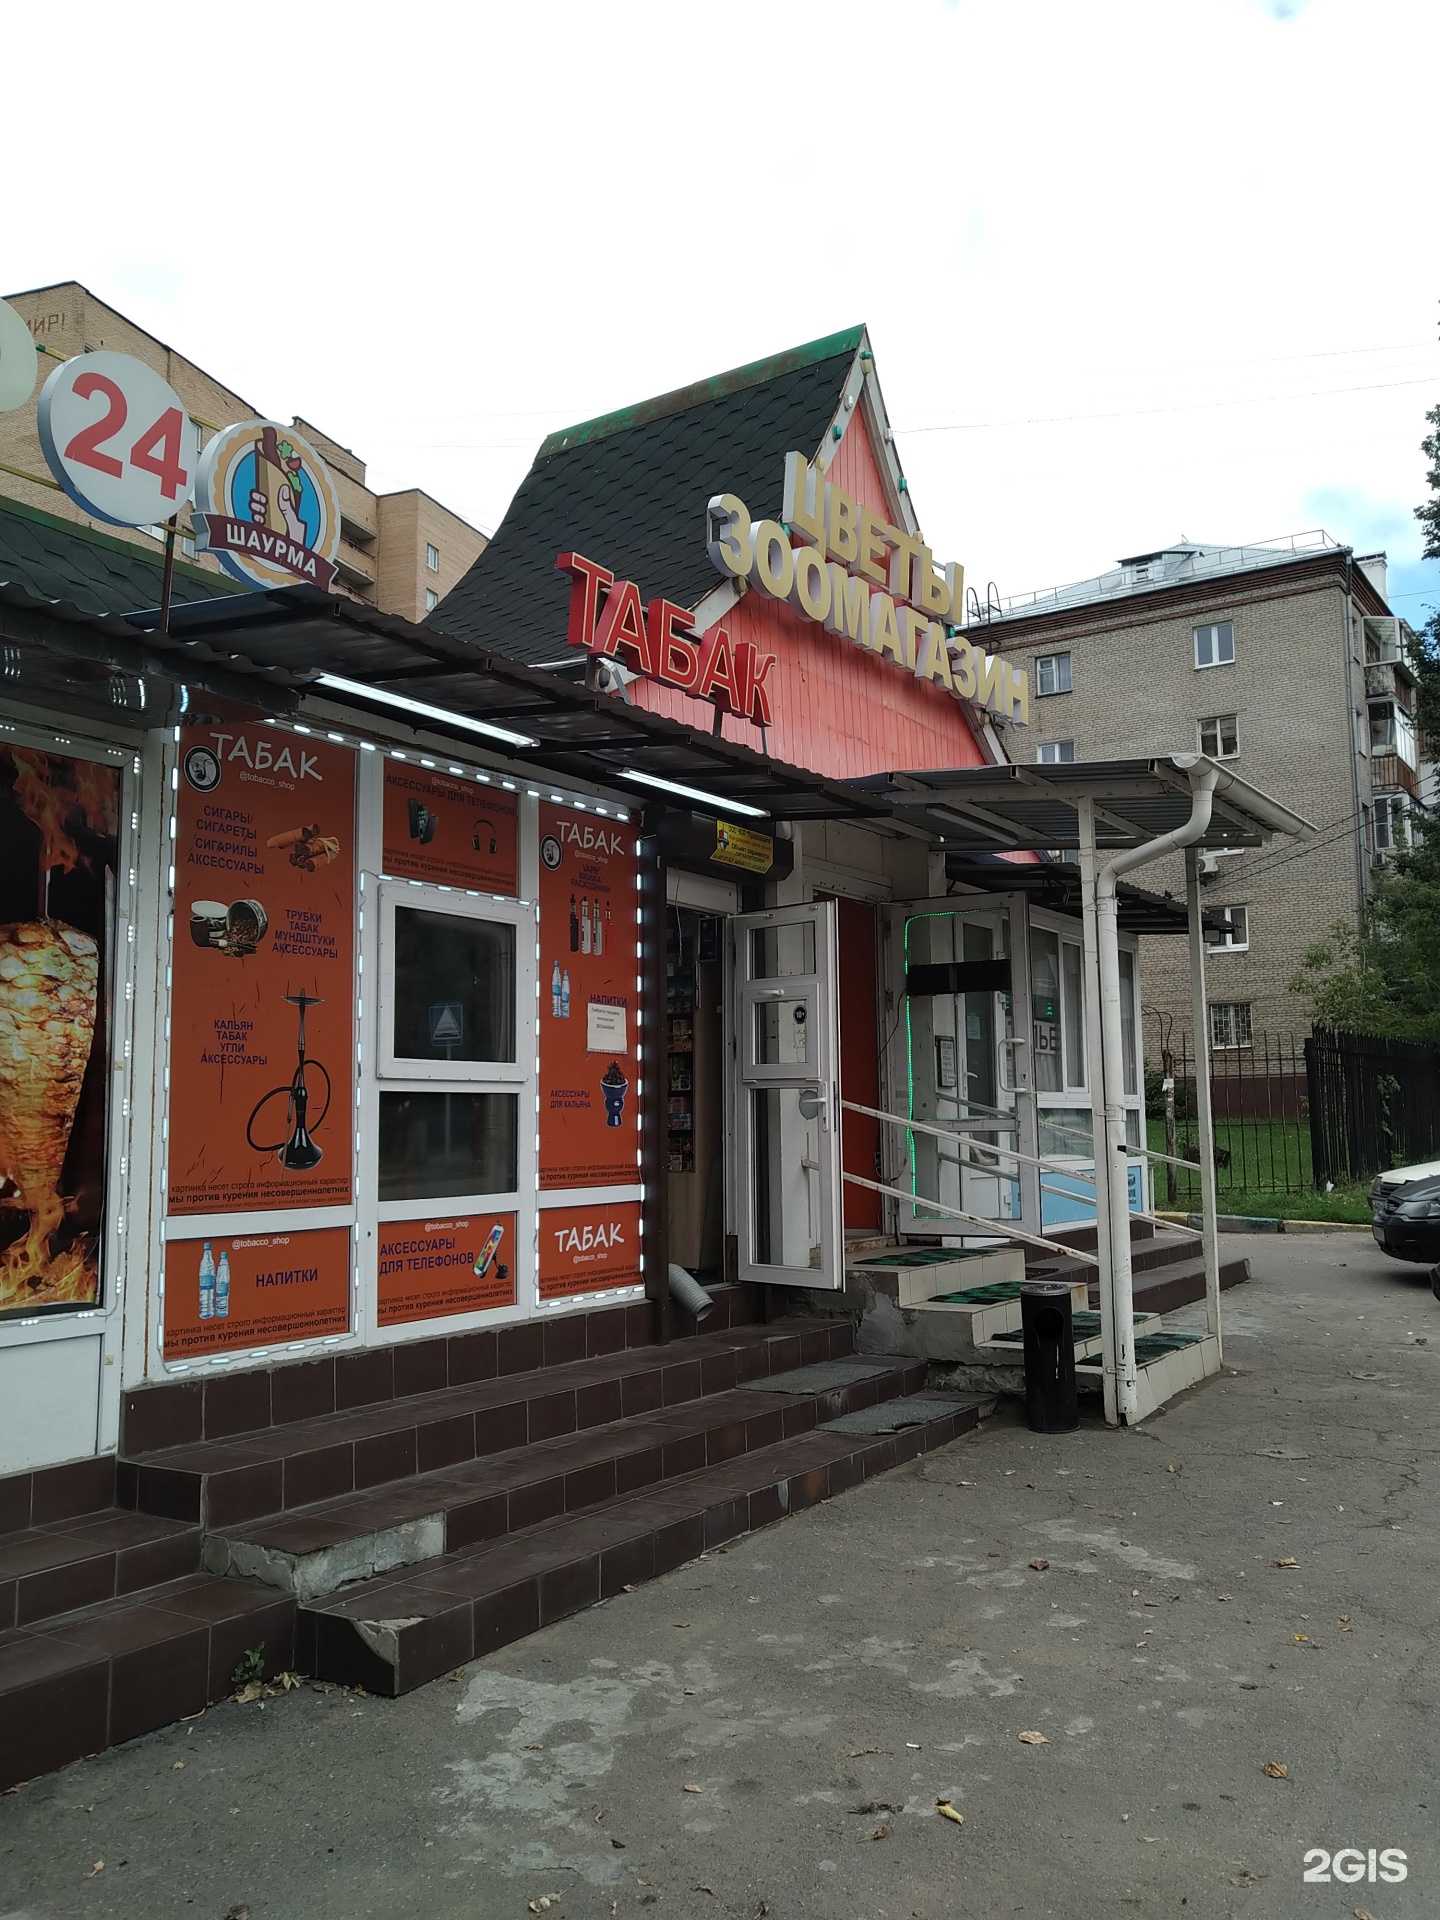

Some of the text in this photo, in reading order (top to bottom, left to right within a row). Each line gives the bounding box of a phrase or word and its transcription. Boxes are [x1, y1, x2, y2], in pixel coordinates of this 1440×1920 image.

[64, 372, 187, 500] 24
[783, 450, 965, 626] ЦВЕТЫ
[226, 523, 317, 577] ШАУРМА
[707, 494, 1028, 727] ЗООМАГАЗИН
[556, 552, 777, 727] ТАБАК
[209, 732, 323, 781] ТАБАК
[203, 805, 251, 825] СИГАРЫ
[196, 818, 257, 840] СИГАРЕТЫ
[556, 821, 625, 856] ТАБАК
[187, 853, 265, 875] АКСЕССУАРЫ
[286, 909, 322, 923] ТРУБКИ
[289, 921, 320, 933] ТАБАК
[274, 930, 336, 946] МУНДШТУКИ
[272, 943, 339, 959] АКСЕССУАРЫ
[214, 1019, 254, 1031] КАЛЬЯН
[216, 1030, 248, 1041] ТАБАК
[220, 1042, 245, 1053] УГЛИ
[200, 1052, 268, 1065] АКСЕССУАРЫ
[550, 1089, 591, 1098] АКСЕССУАРЫ
[169, 1195, 184, 1204] мы
[187, 1192, 220, 1205] против
[222, 1190, 259, 1202] курения
[232, 1237, 289, 1250] @tobacco_shop
[380, 1238, 456, 1256] АКСЕССУАРЫ
[554, 1222, 625, 1253] ТАБАК
[379, 1251, 474, 1275] ДЛЯ ТЕЛЕФОНОВ
[256, 1268, 318, 1288] НАПИТКИ
[182, 1334, 216, 1348] против
[217, 1328, 255, 1342] курения
